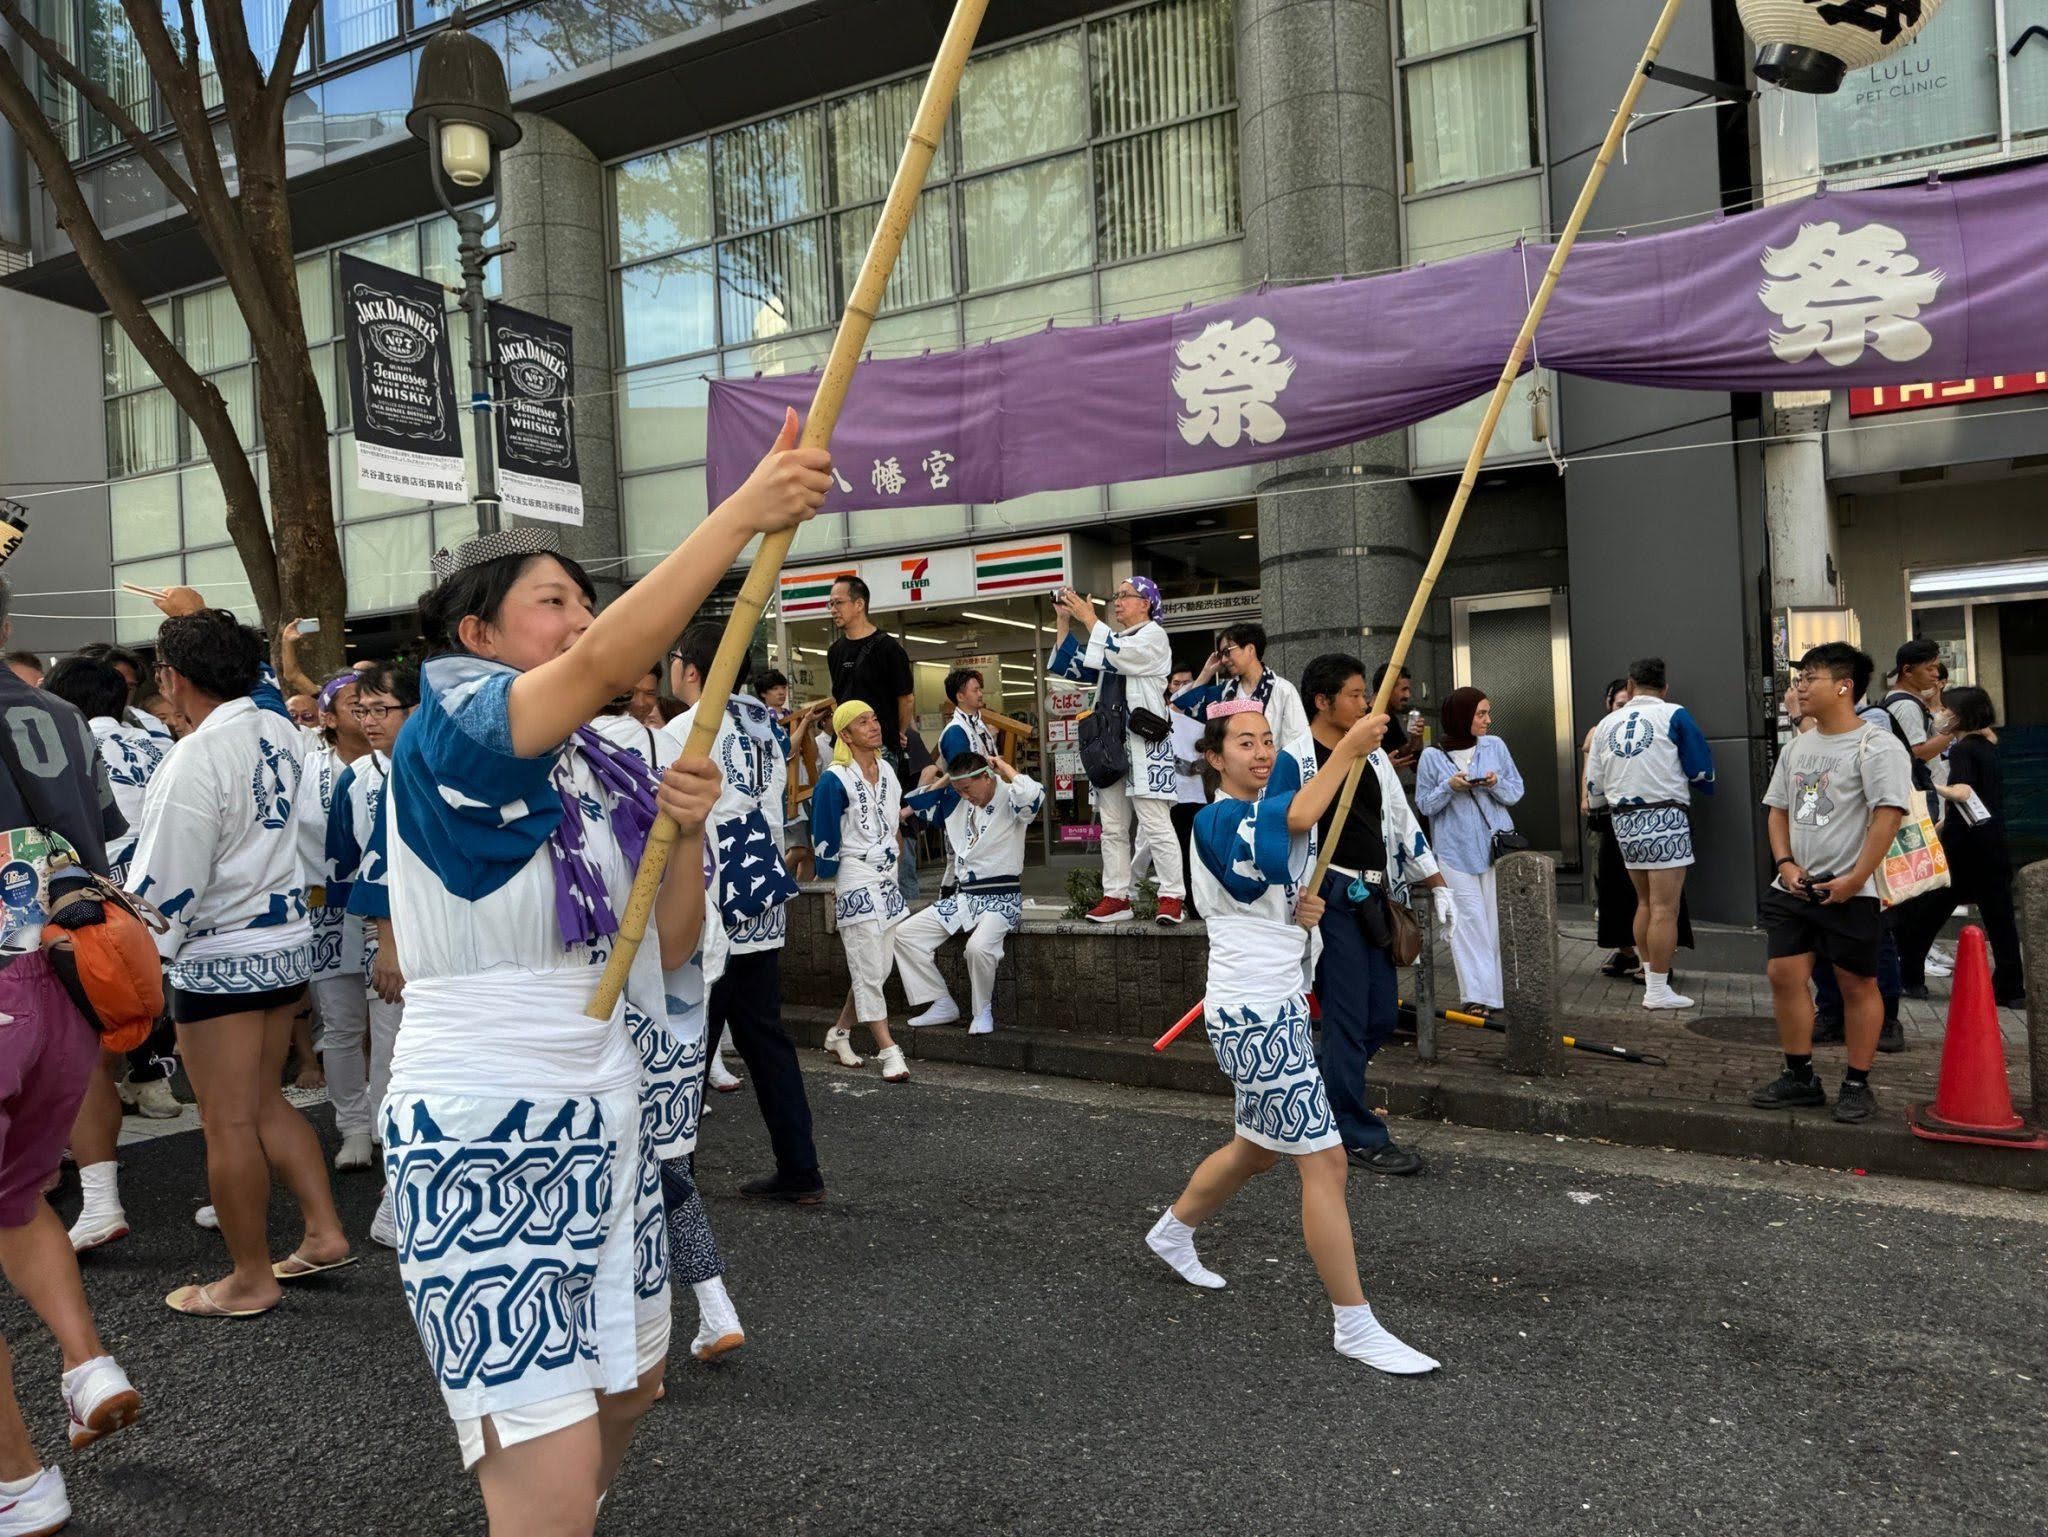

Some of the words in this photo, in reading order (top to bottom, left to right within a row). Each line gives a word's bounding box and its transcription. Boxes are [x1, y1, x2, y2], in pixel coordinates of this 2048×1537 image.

[1870, 59, 1930, 83] LULU
[1856, 89, 1882, 104] PET
[1889, 76, 1948, 97] CLINIC
[1757, 221, 1948, 367] 祭
[355, 300, 388, 325] JACK
[386, 297, 439, 344] DANIEL'S
[498, 342, 527, 365] JACK
[525, 339, 569, 380] DANIEL'S
[373, 361, 429, 388] Tennessee
[1171, 316, 1298, 448] 祭
[371, 383, 434, 407] WHISKEY
[510, 416, 562, 437] WHISKEY
[901, 557, 929, 602] 7
[1051, 693, 1083, 710] たばこ
[1797, 753, 1820, 770] PLAY
